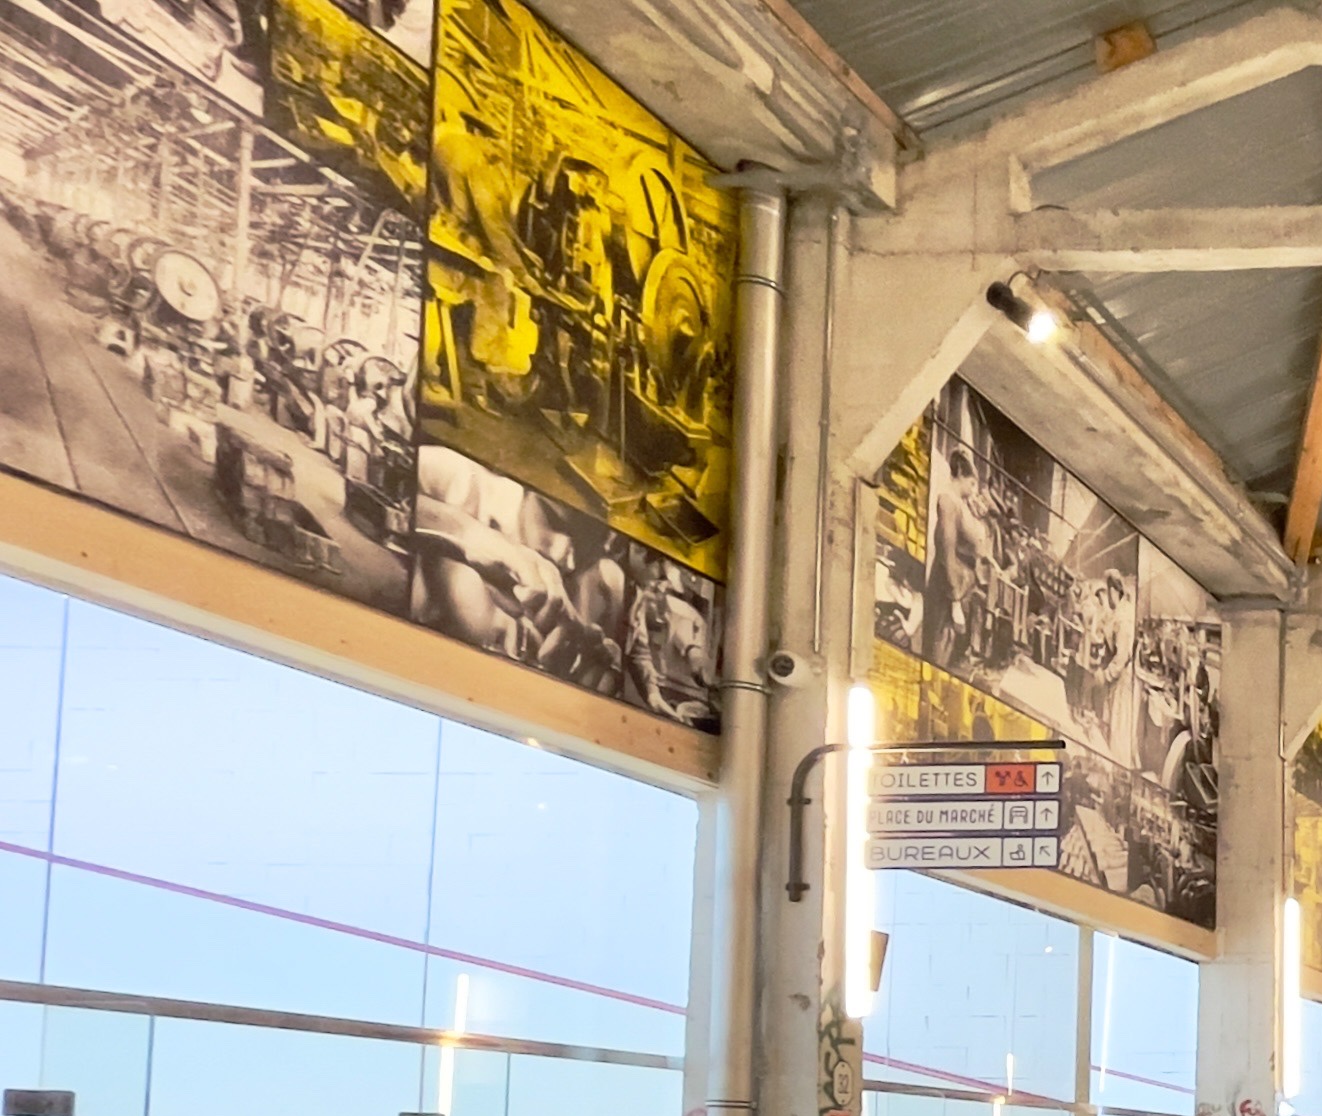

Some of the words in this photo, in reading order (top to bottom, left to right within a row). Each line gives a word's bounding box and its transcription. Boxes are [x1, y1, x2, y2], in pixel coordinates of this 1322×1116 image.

[916, 809, 934, 824] DU
[939, 803, 995, 825] MARCHÉ
[869, 844, 990, 861] BUREAUX
